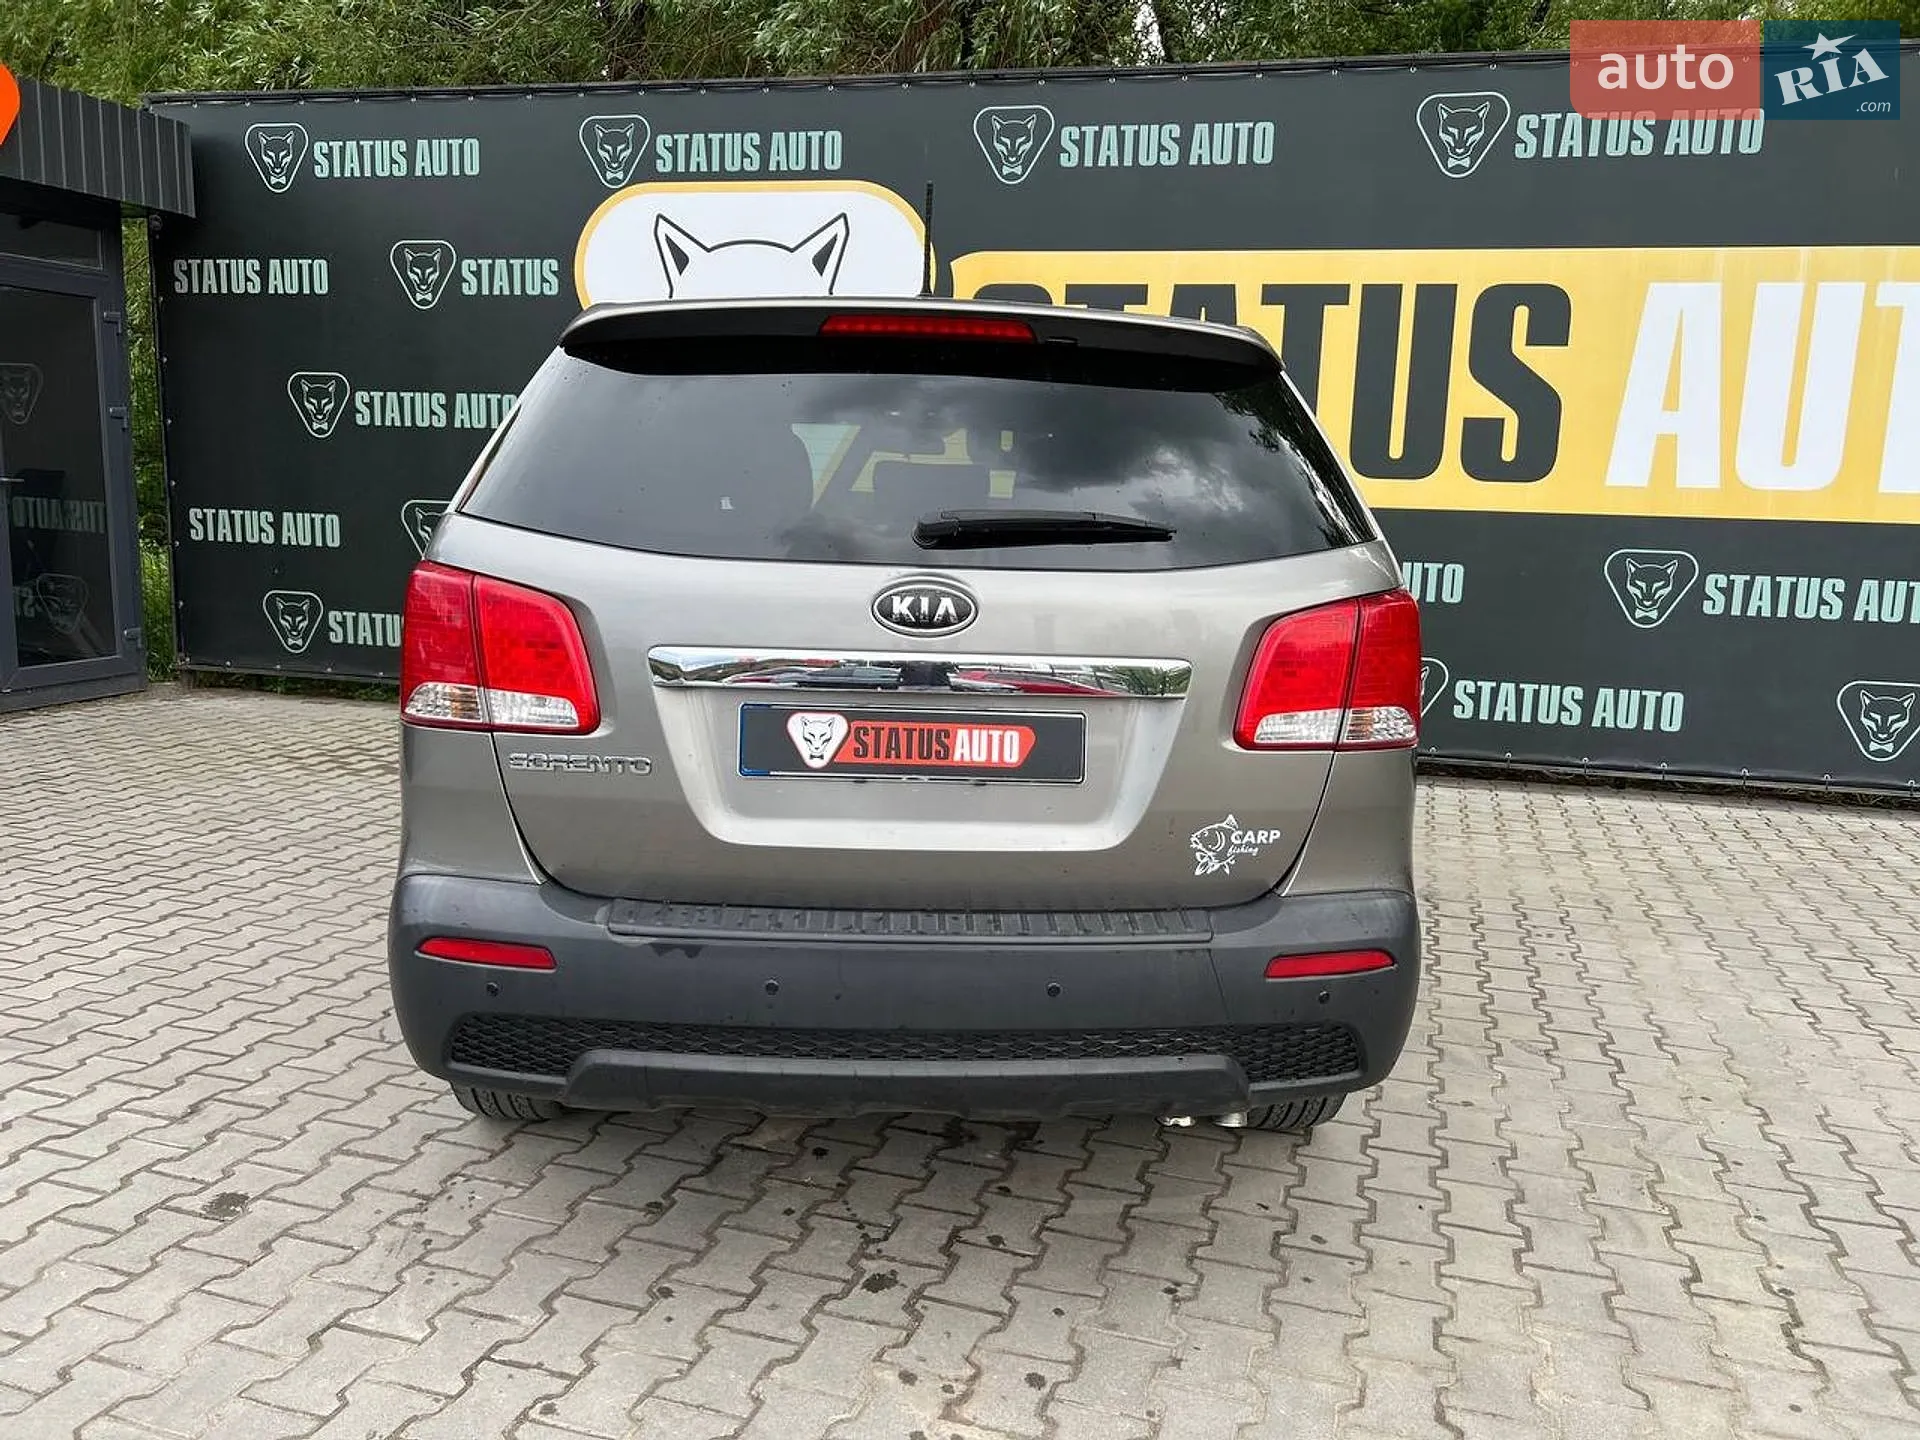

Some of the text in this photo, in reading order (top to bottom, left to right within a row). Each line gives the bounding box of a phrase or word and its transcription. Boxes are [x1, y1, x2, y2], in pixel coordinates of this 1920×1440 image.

[655, 130, 842, 172] STATUS AUTO
[1059, 121, 1275, 168] STATUS AUTO
[1515, 108, 1766, 159] STATUS AUTO
[313, 138, 480, 178] STATUS AUTO
[173, 258, 329, 295] STATUS AUTO
[461, 258, 559, 296] STATUS
[1605, 281, 1920, 495] AUT
[355, 391, 446, 429] STATUS
[189, 508, 341, 548] STATUS AUTO
[1402, 562, 1464, 603] UTO
[1703, 572, 1920, 624] STATUS AUT
[328, 610, 402, 648] STATU
[891, 595, 958, 624] KIA
[1453, 679, 1685, 733] STATUS AUTO
[508, 752, 652, 776] SORENTO
[853, 725, 1020, 764] STATUS AUTO
[1230, 829, 1281, 844] CARP
